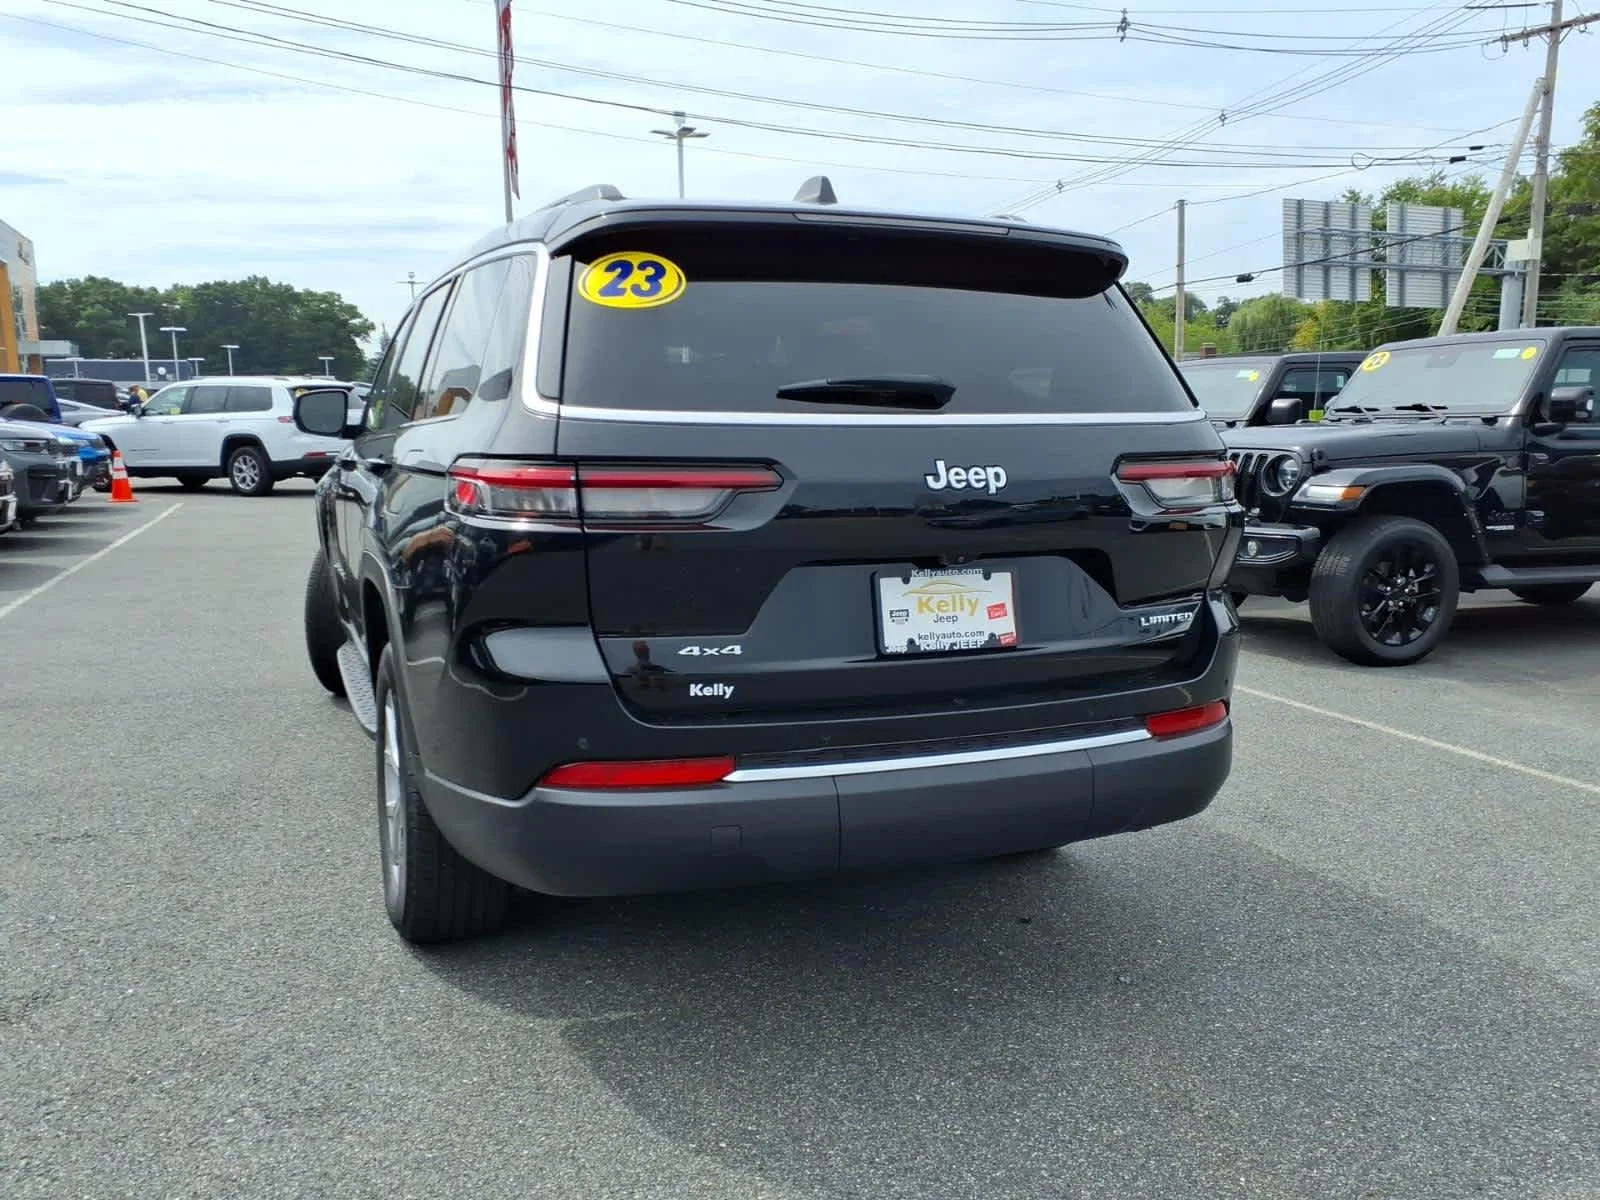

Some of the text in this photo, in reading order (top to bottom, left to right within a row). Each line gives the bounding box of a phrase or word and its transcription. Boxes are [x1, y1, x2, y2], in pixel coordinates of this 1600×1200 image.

[599, 259, 666, 297] 23
[925, 459, 1007, 494] Jeep
[911, 568, 984, 578] Kellyauto.com
[917, 595, 979, 616] Kelly
[933, 614, 958, 624] Jeep
[1140, 612, 1193, 626] LIMITED
[918, 630, 984, 641] kellyauto.com
[678, 645, 743, 656] 4x4
[920, 640, 985, 651] Kelly JEEP
[689, 683, 735, 699] Kelly
